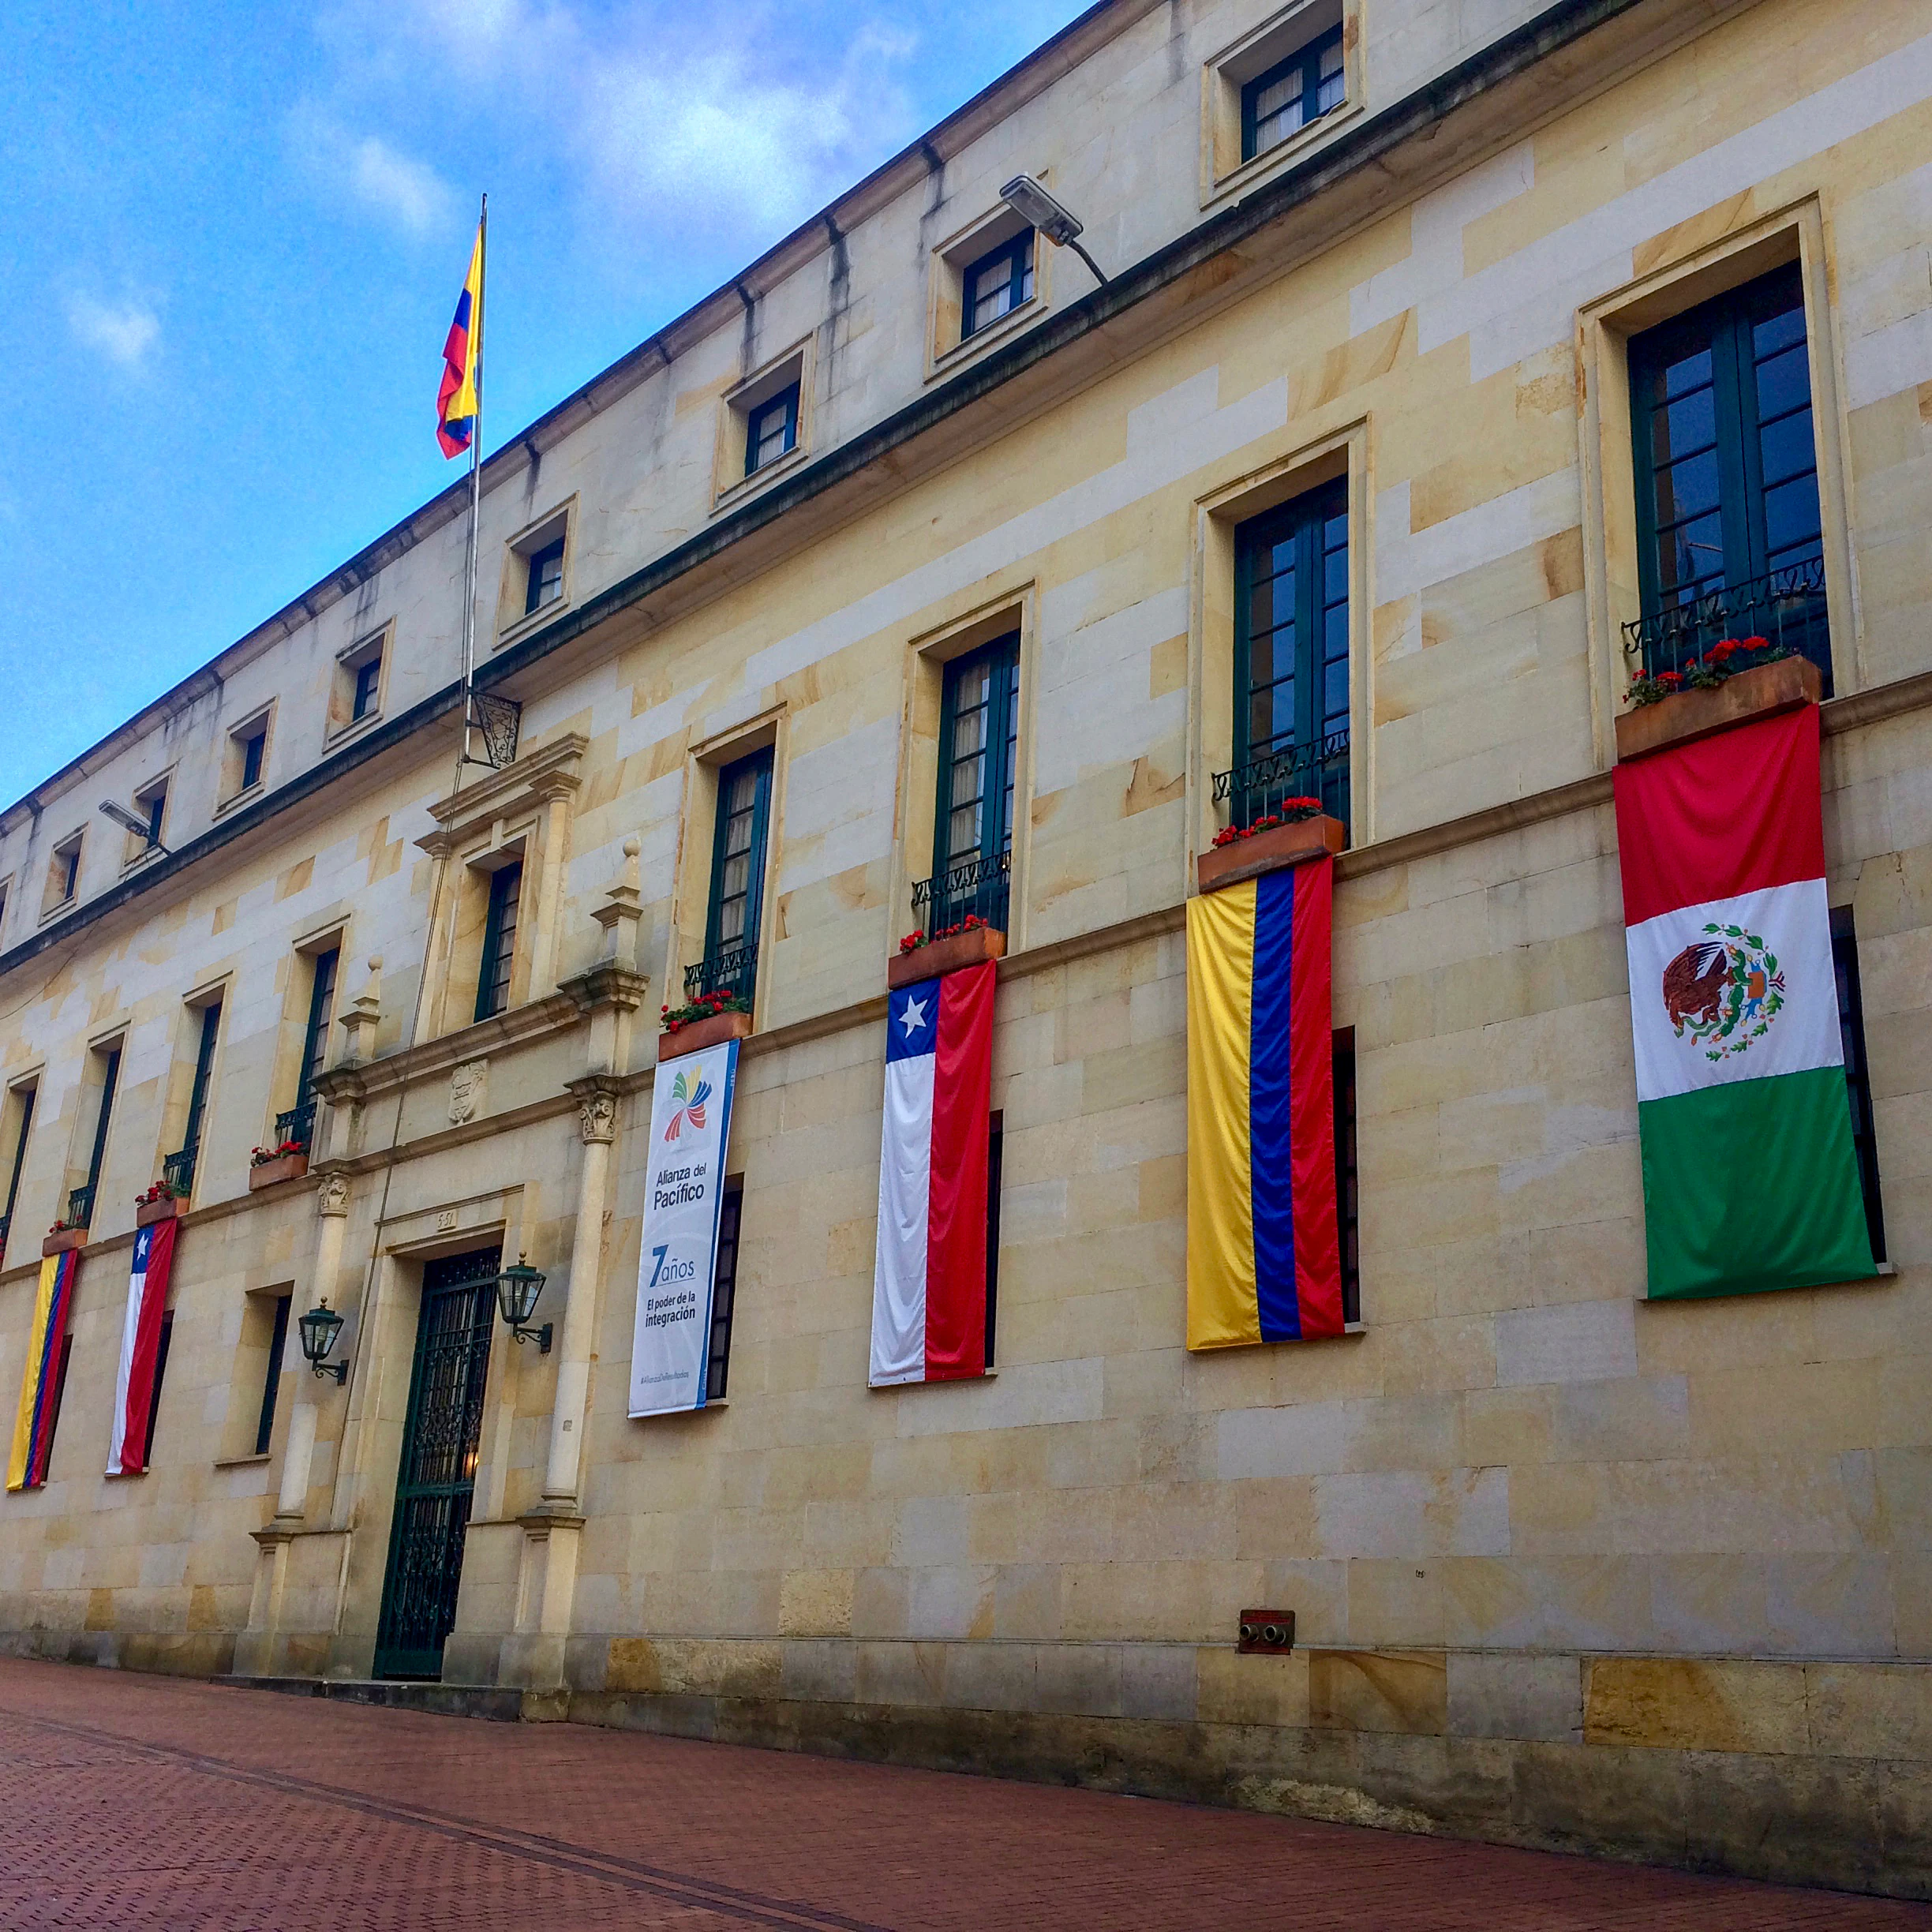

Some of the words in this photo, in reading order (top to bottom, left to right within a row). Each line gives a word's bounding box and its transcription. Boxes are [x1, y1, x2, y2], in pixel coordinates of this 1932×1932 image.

[657, 1167, 690, 1187] Alianza
[694, 1163, 707, 1177] del
[653, 1184, 704, 1210] Pacífico
[647, 1297, 654, 1311] El
[654, 1294, 675, 1312] poder
[676, 1292, 687, 1305] de
[688, 1290, 695, 1302] la
[646, 1305, 695, 1327] integración
